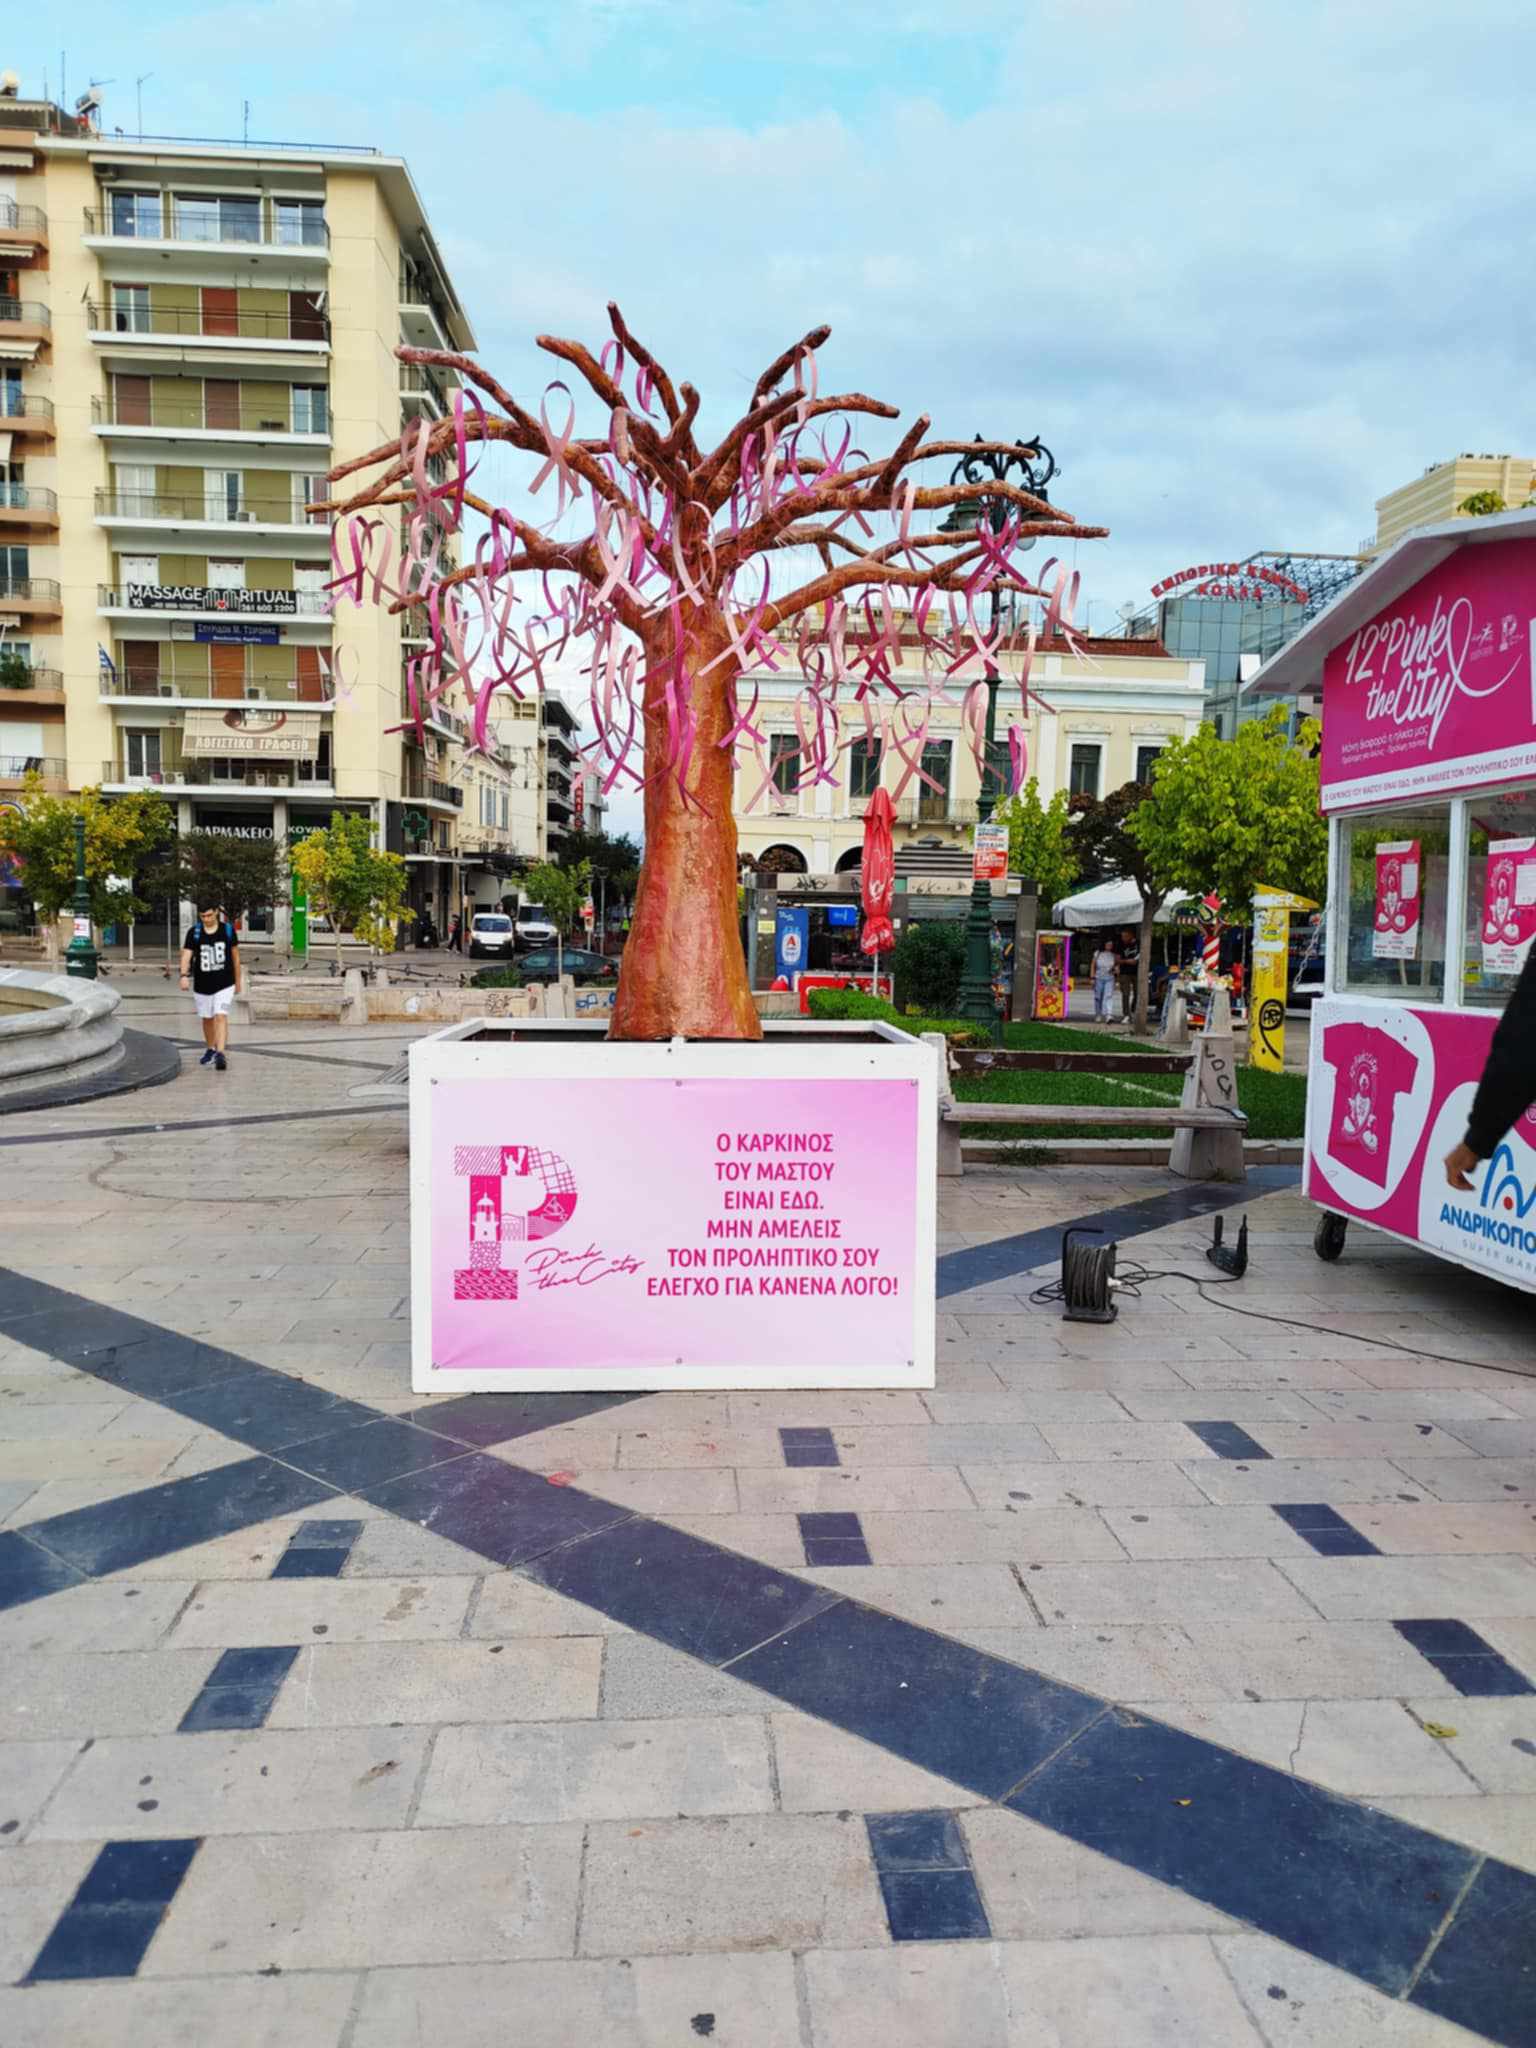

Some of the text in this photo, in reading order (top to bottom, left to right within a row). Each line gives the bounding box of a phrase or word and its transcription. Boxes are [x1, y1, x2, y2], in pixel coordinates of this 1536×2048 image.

[1151, 563, 1239, 598] ΕΜΠΟΡΙΚΟ
[129, 584, 204, 600] MASSAGE
[240, 589, 295, 604] RITUAL
[195, 735, 309, 751] ΛΟΓΙΣΤΙΚΟ ΓΡΑΦΕΙΟ
[192, 826, 274, 840] ΦΑΡΜΑΚΕΙΟ
[737, 1133, 834, 1152] ΚΑΡΚΙΝΟΣ
[715, 1162, 834, 1181] ΤΟΥ ΜΑΣΤΟΥ
[724, 1191, 824, 1210] ΕΙΝΑΙ ΕΔΩ.
[707, 1219, 841, 1239] ΜΗΝ ΑΜΕΛΕΙΣ
[525, 1242, 602, 1275] Pink
[668, 1248, 879, 1267] ΤΟΝ ΠΡΟΛΗΠΤΙΚΟ ΣΟΥ
[1463, 1239, 1536, 1273] SUPER MAR
[647, 1277, 898, 1296] ΕΛΕΓΧΟ ΓΙΑ ΚΑΝΕΝΑ ΛΟΓΟ!
